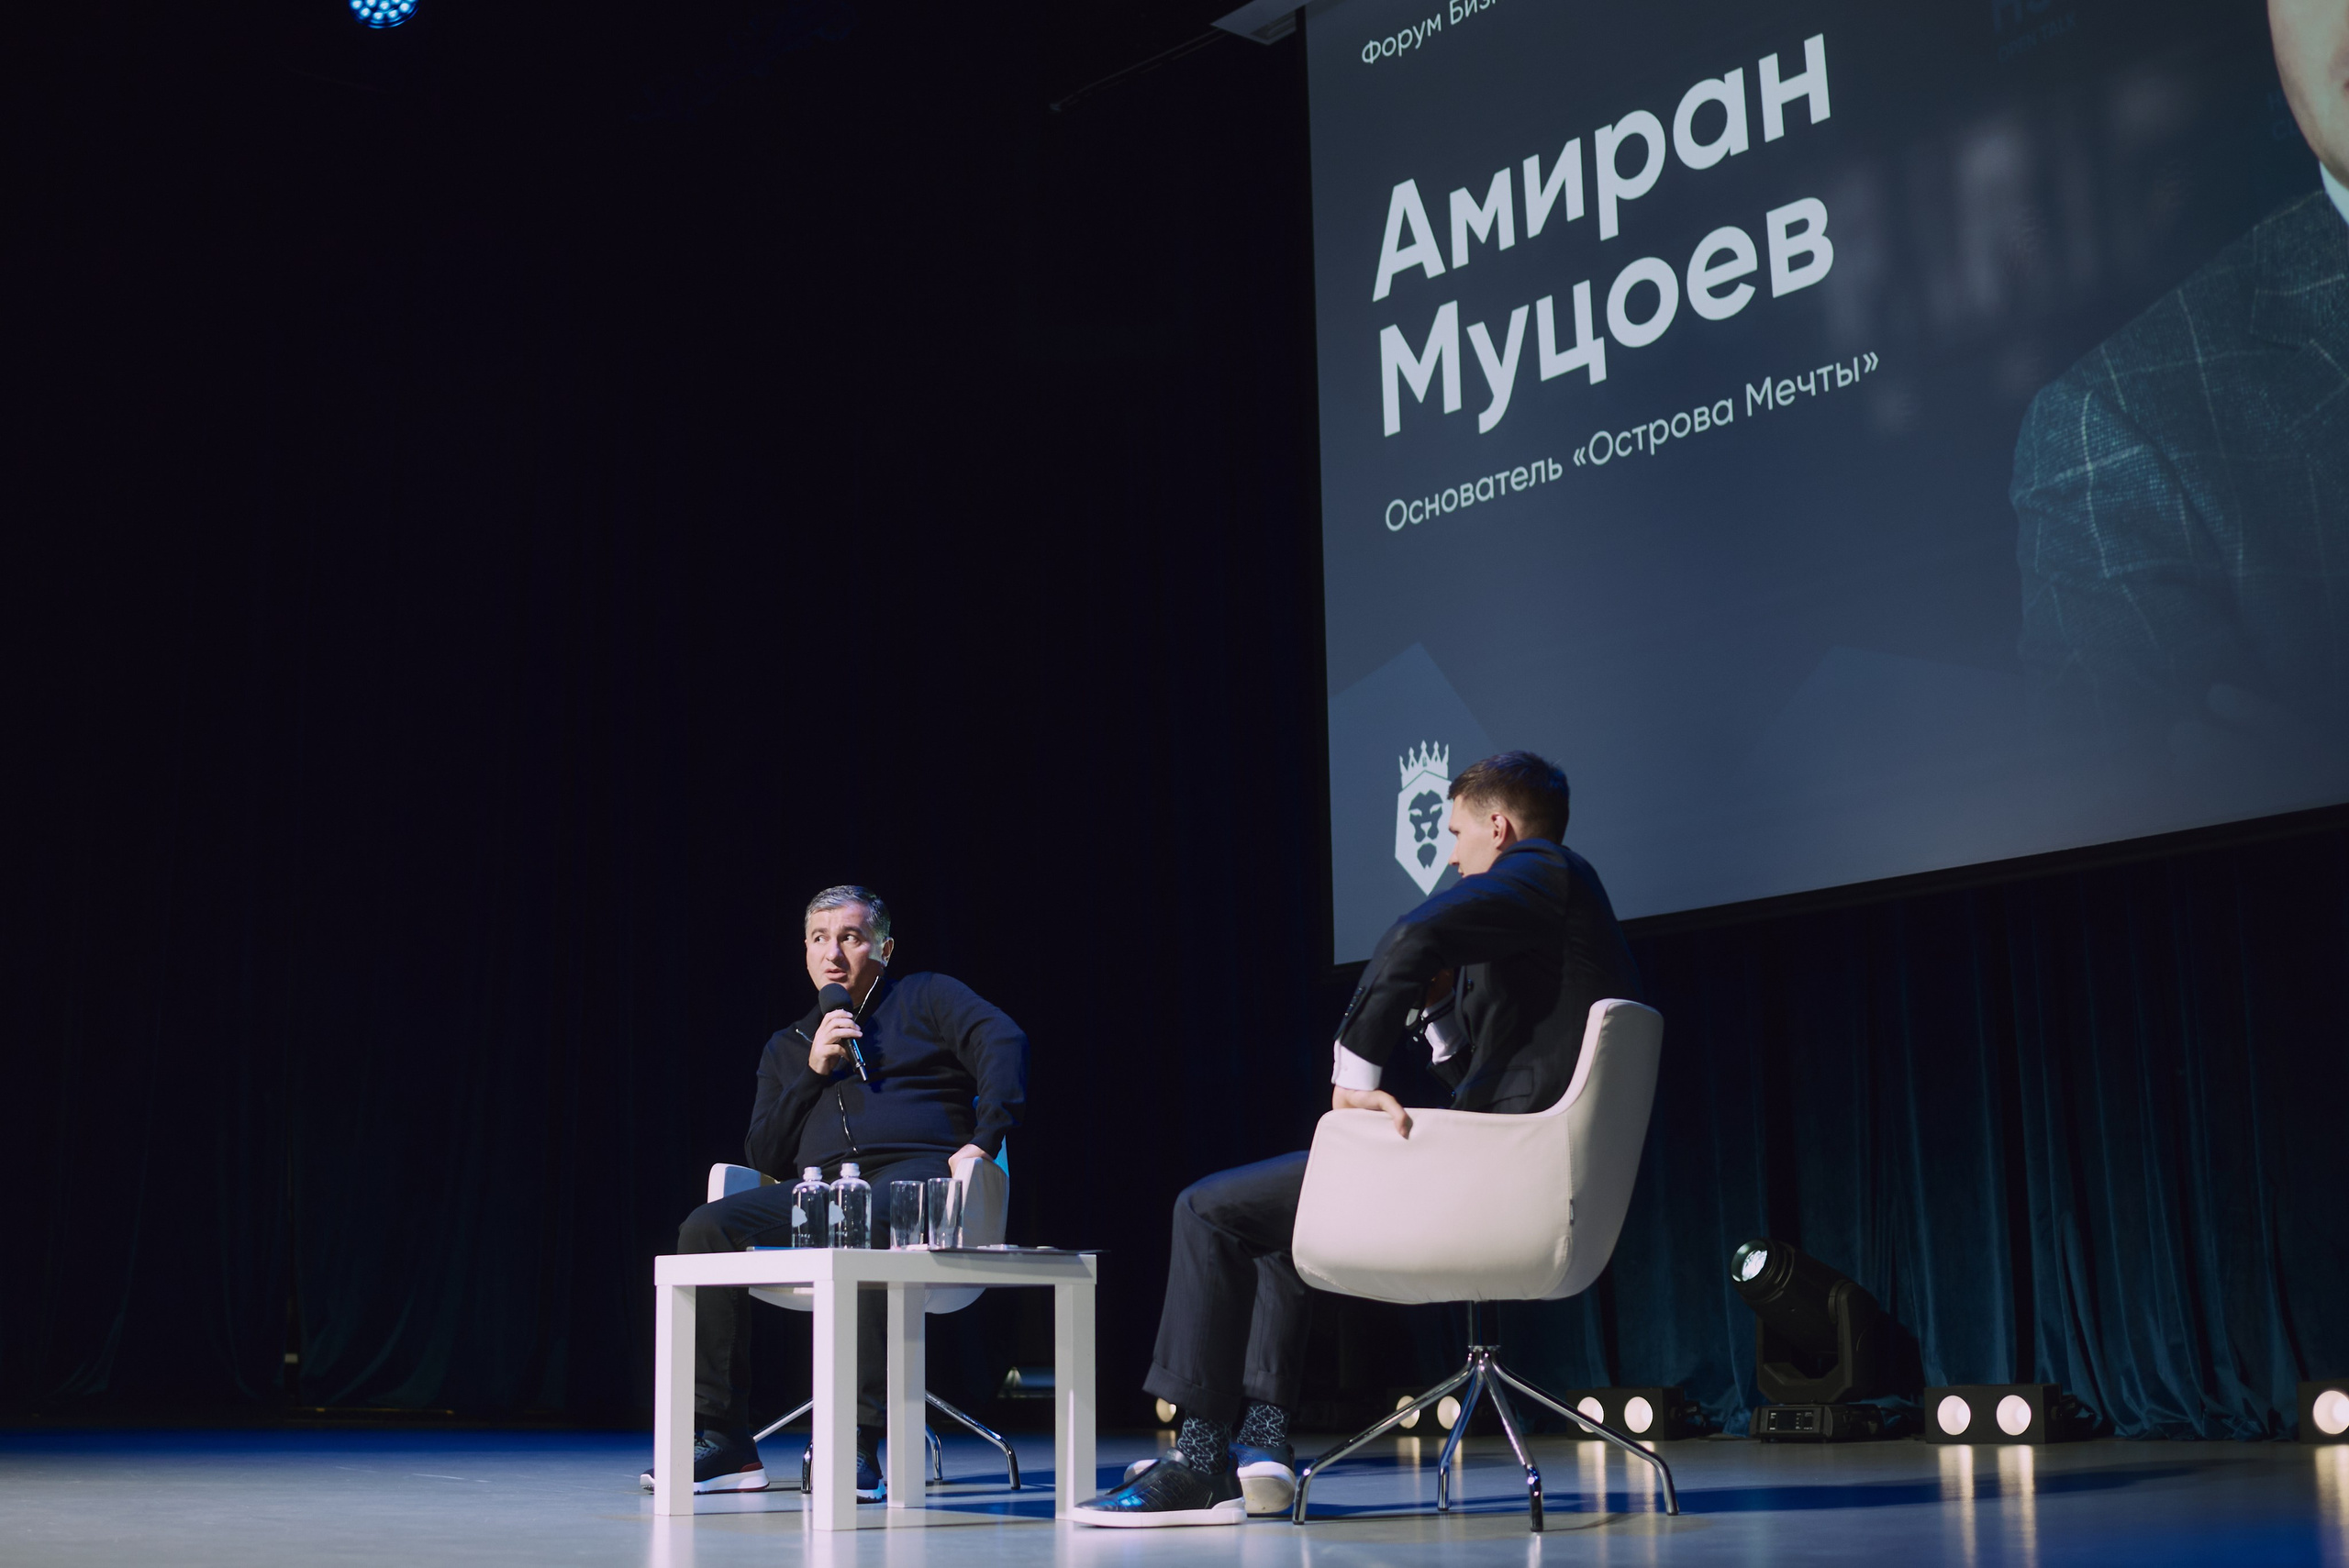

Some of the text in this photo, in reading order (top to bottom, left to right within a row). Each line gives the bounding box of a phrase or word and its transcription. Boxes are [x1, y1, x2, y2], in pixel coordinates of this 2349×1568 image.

[1361, 0, 1497, 64] Форум Биз
[1373, 33, 1831, 302] Амиран
[1380, 197, 1833, 437] Муцоев
[1385, 350, 1879, 532] Основатель «Острова Мечты»
